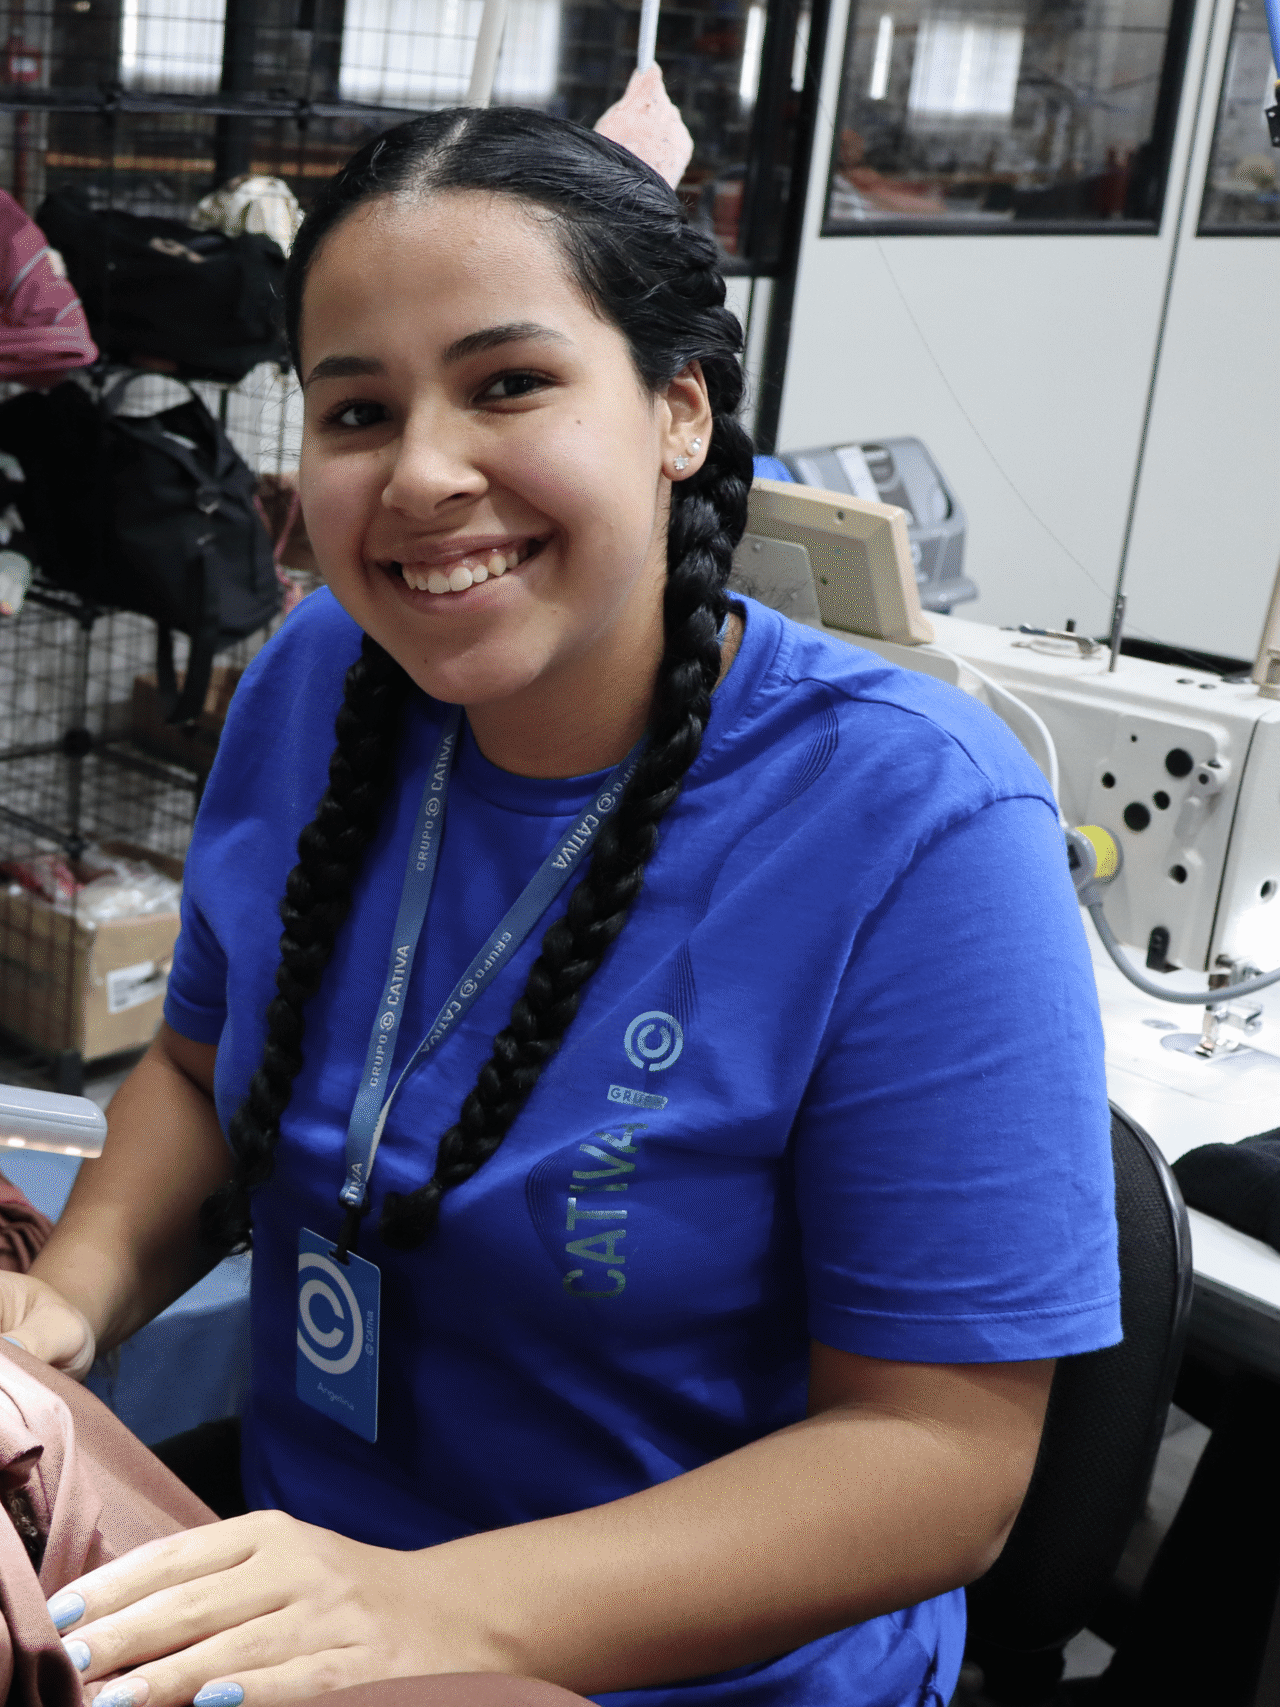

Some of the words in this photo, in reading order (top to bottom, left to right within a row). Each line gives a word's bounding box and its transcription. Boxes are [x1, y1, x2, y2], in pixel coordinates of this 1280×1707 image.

[416, 820, 434, 871] GRUPO
[431, 733, 454, 791] CATIVA
[551, 814, 600, 869] CATIVA
[474, 931, 513, 979] GRUPO
[369, 1034, 388, 1087] GRUPO
[386, 944, 411, 1006] CATIVA
[420, 1000, 462, 1053] CATIVA
[562, 1122, 650, 1299] CATIVA
